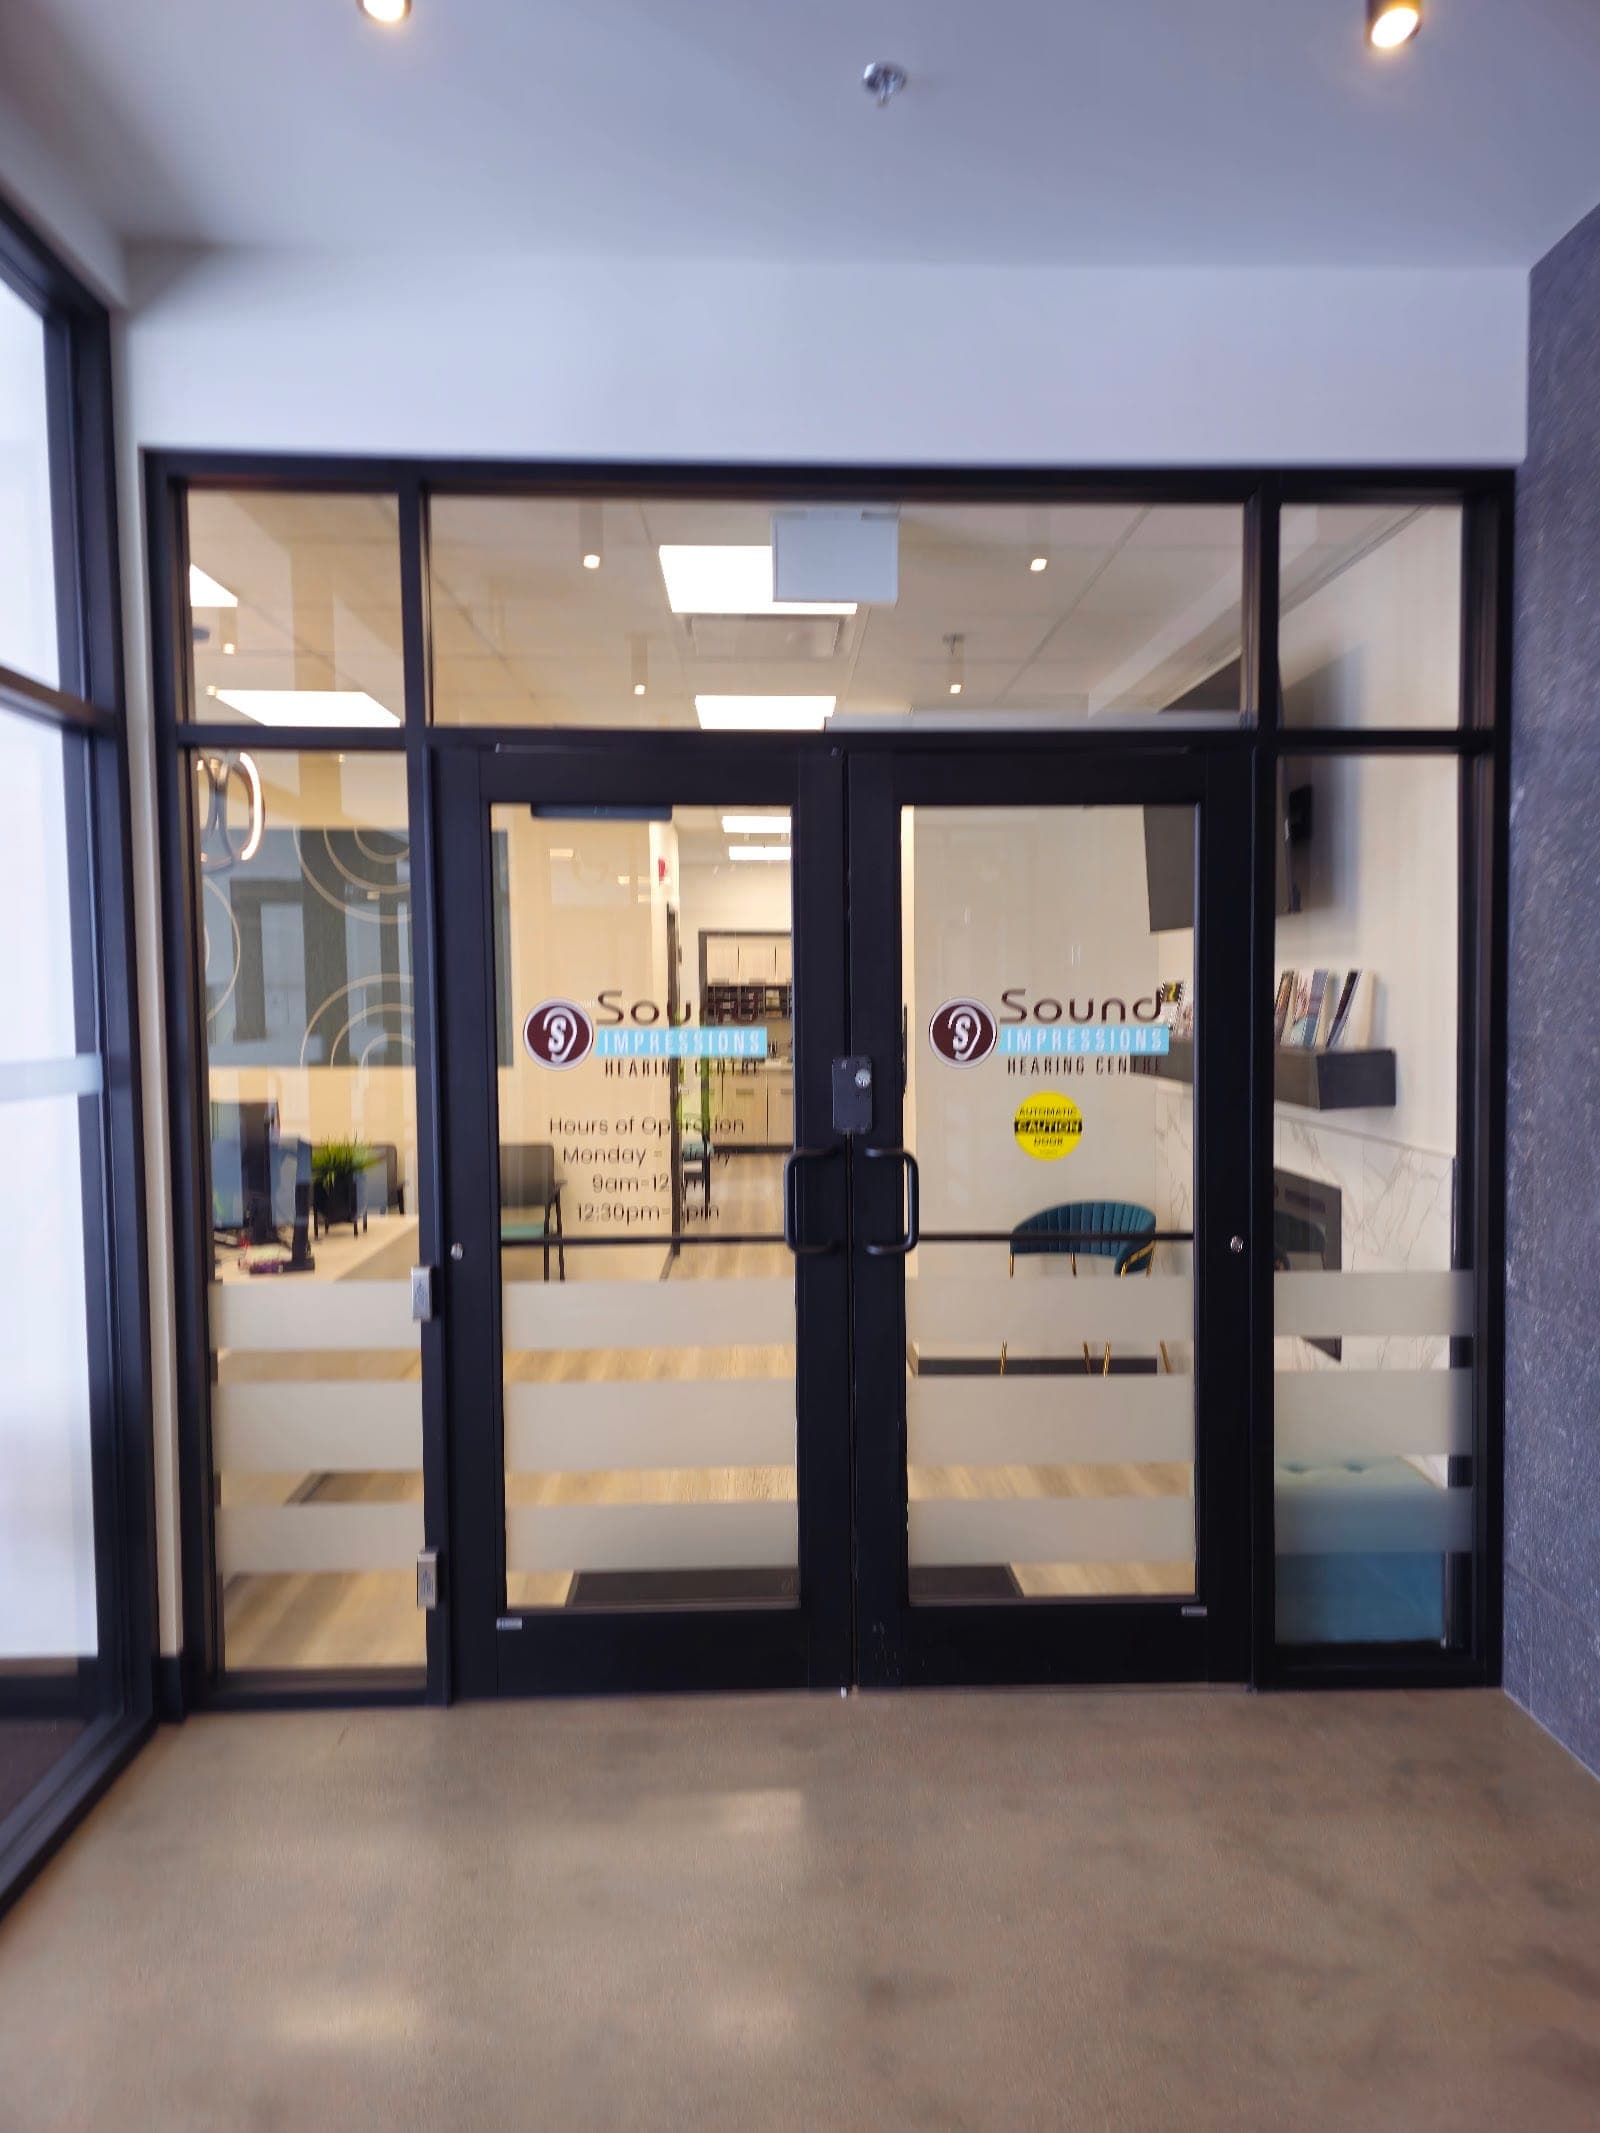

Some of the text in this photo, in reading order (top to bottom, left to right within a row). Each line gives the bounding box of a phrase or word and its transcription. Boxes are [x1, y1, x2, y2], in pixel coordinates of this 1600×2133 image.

[1000, 988, 1162, 1025] Sound
[603, 1029, 760, 1054] IMPRESSIONS
[1007, 1027, 1162, 1051] IMPRESSIONS
[604, 1058, 760, 1079] HEARIN CNTRE
[1007, 1056, 1085, 1076] HEARING
[549, 1115, 744, 1140] Hours of Opraion
[1017, 1120, 1079, 1134] CAUTION
[562, 1143, 648, 1167] Monday
[576, 1203, 720, 1224] 12:30pm-pm
